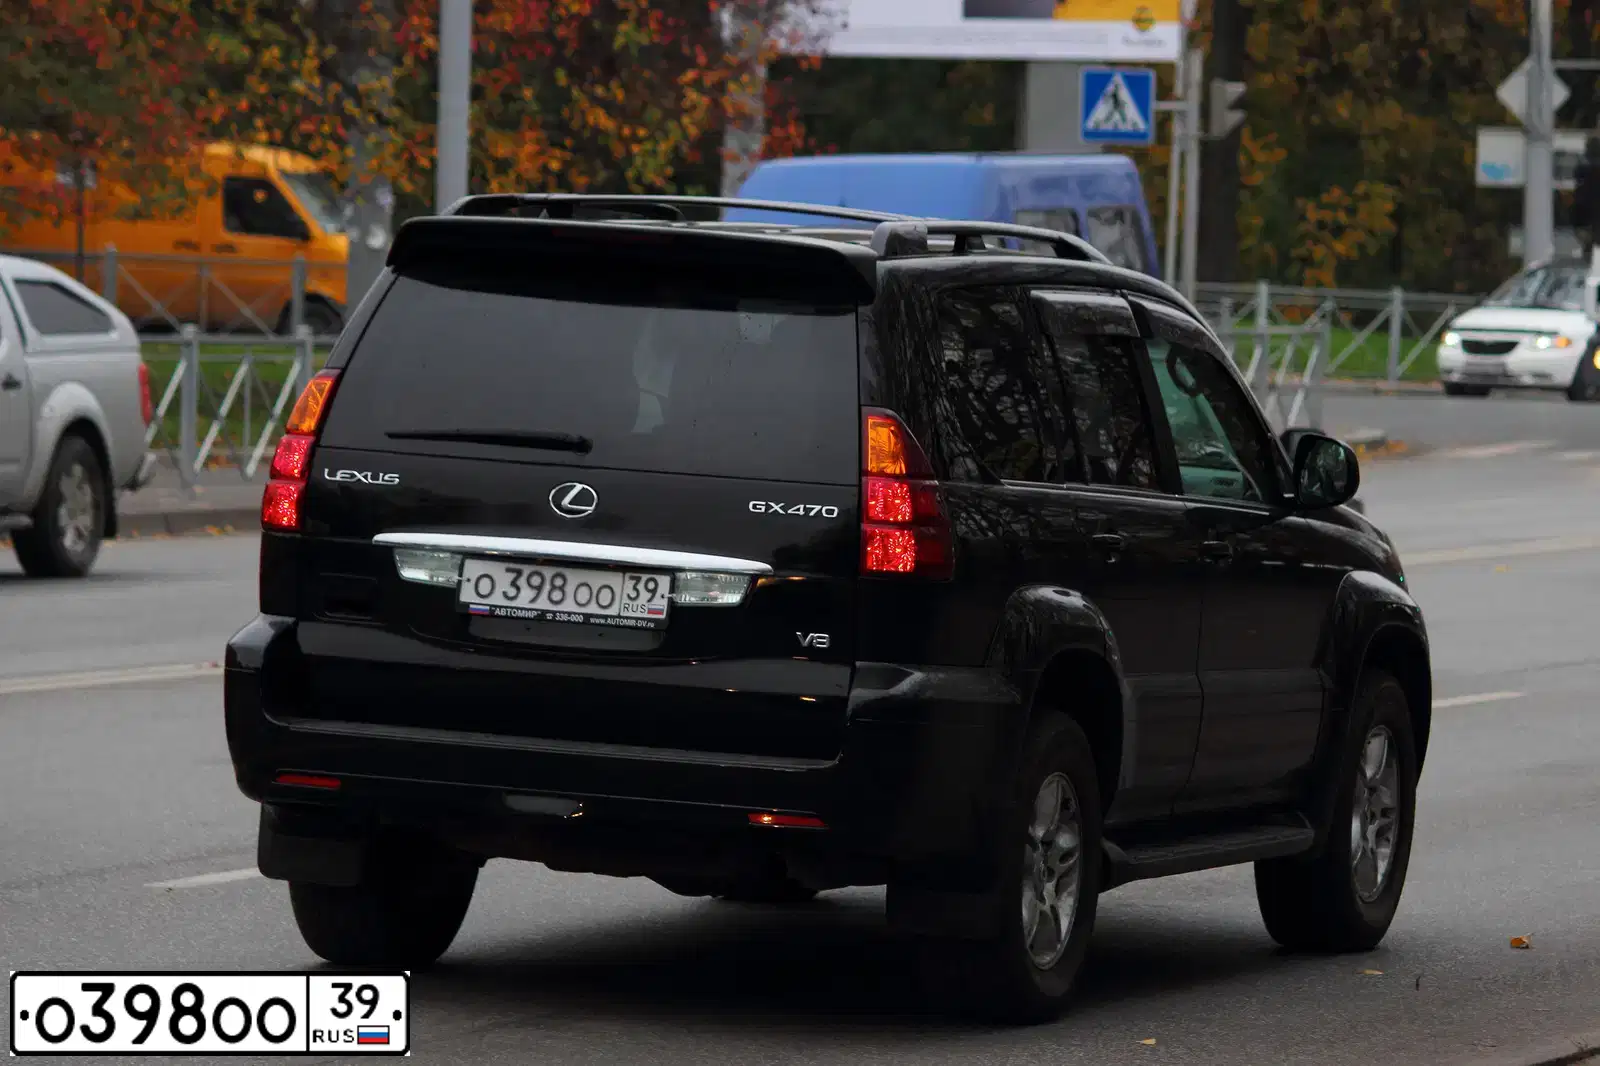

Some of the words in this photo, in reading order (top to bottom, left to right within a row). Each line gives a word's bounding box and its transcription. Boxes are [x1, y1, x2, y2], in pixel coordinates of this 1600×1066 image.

[324, 468, 400, 485] LEXUS
[626, 575, 659, 603] 39
[623, 602, 647, 614] RUS
[795, 631, 830, 648] V8
